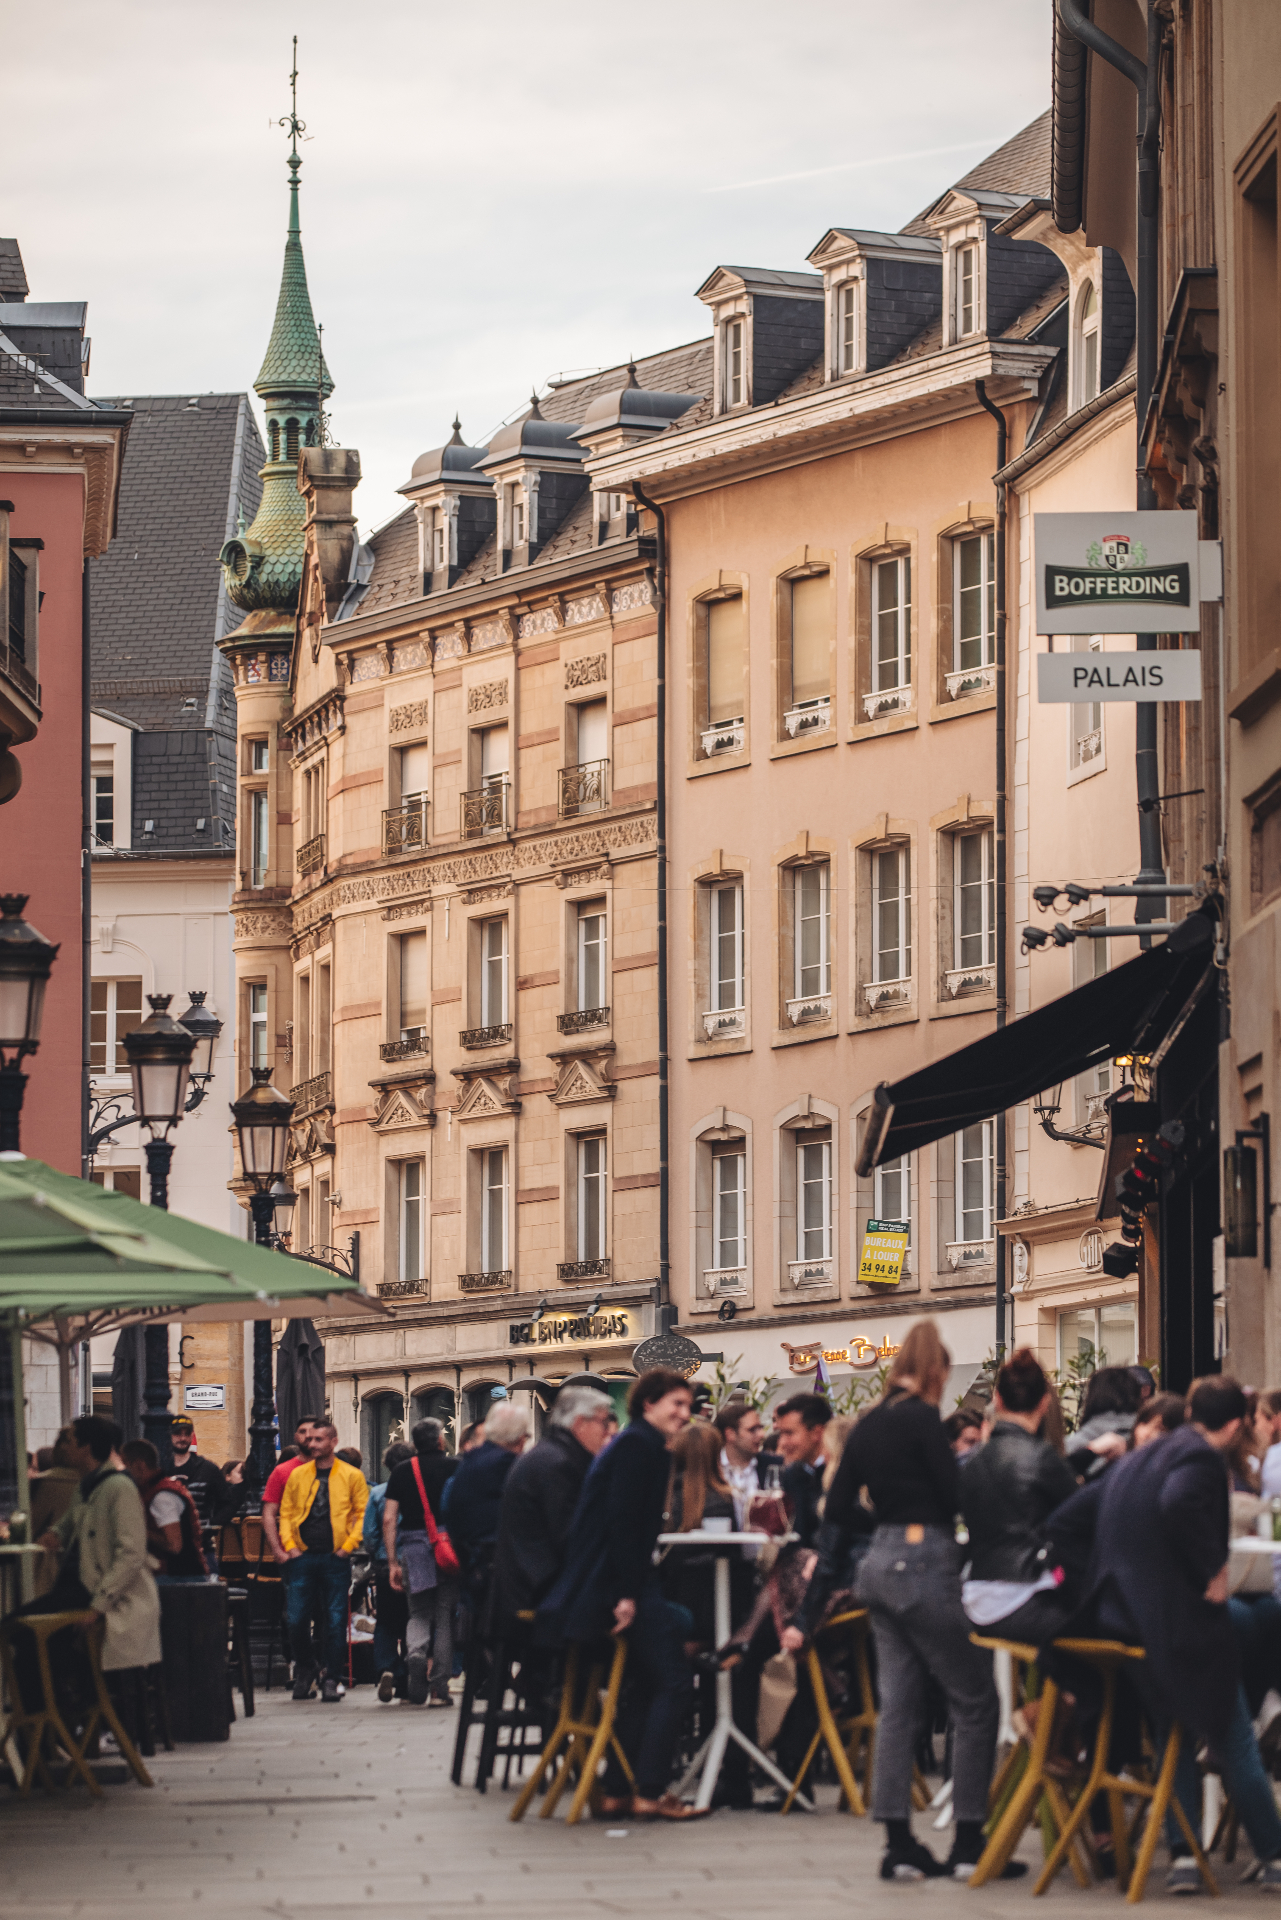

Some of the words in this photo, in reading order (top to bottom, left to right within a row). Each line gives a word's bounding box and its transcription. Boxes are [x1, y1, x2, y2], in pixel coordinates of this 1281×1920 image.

[1054, 574, 1180, 596] BOFFERDING
[1073, 665, 1164, 688] PALAIS
[865, 1236, 904, 1249] BUREAUX
[873, 1251, 900, 1262] LOUER
[861, 1262, 872, 1273] 34
[875, 1263, 886, 1274] 94
[888, 1265, 899, 1275] 84
[509, 1322, 537, 1344] BGL
[538, 1320, 565, 1341] BNP
